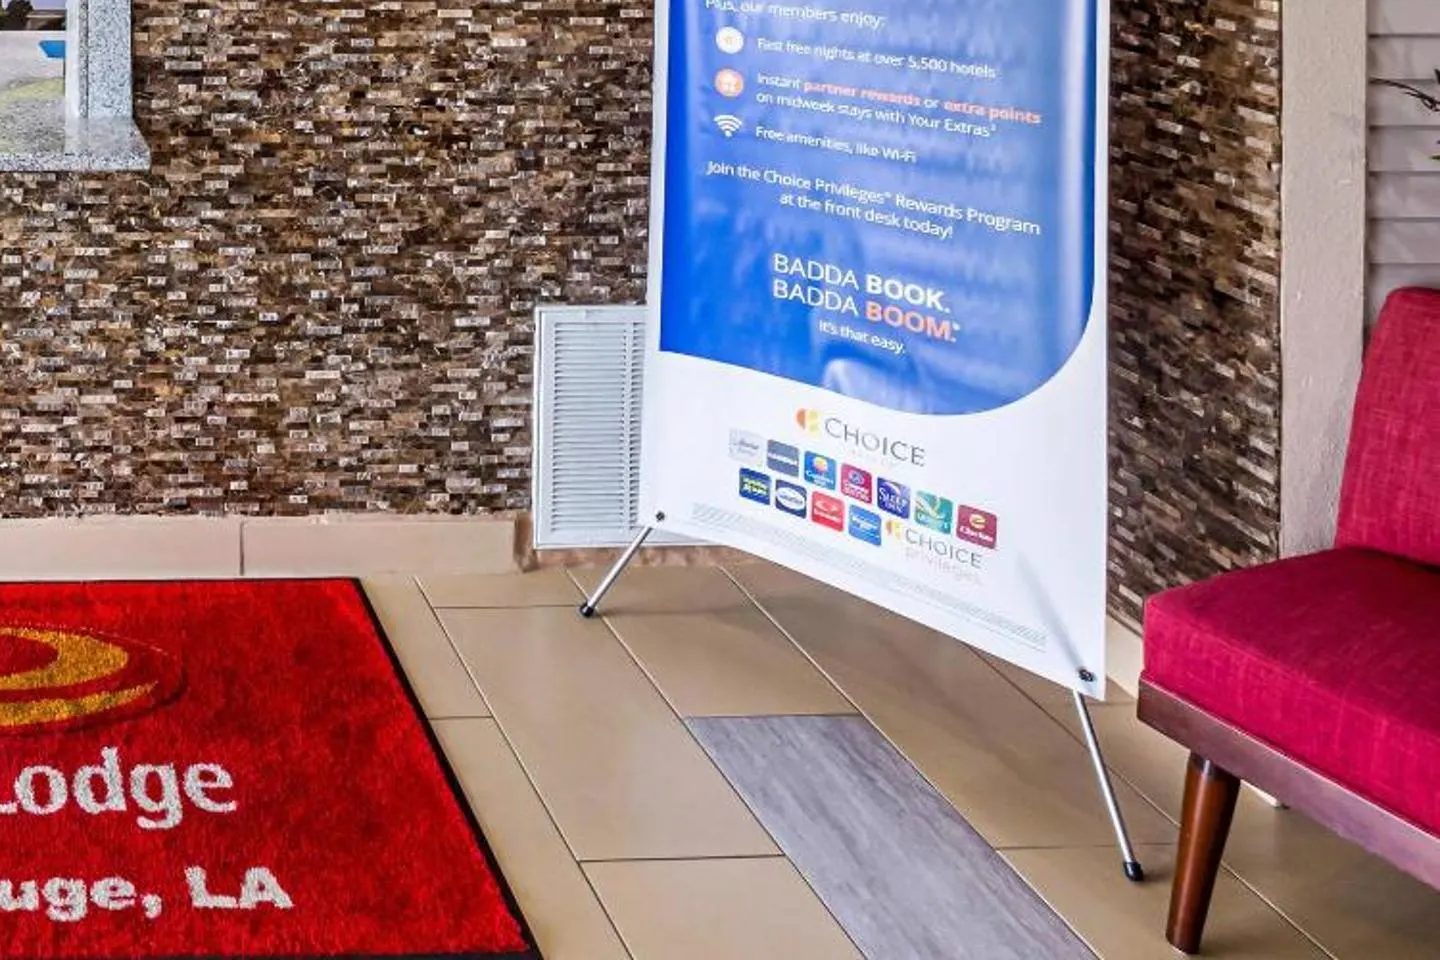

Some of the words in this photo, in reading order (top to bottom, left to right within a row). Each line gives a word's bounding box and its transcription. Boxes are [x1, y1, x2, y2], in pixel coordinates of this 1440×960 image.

[740, 1, 764, 13] our
[768, 3, 838, 22] members
[813, 45, 855, 61] nights
[857, 49, 871, 62] at
[874, 53, 905, 67] over
[756, 92, 773, 104] on
[776, 95, 835, 113] midweek
[875, 109, 905, 124] with
[908, 113, 941, 129] Your
[757, 73, 800, 89] Instant
[860, 88, 921, 106] rewards
[924, 97, 939, 108] or
[944, 100, 986, 117] extra
[988, 106, 1041, 124] points
[755, 126, 784, 141] Free
[855, 143, 879, 157] like
[706, 161, 734, 176] Join
[737, 164, 761, 181] the
[763, 169, 811, 189] Choice
[896, 193, 963, 220] Rewards
[967, 208, 1040, 235] Program
[779, 193, 795, 205] at
[798, 195, 821, 211] the
[824, 199, 861, 217] front
[864, 208, 901, 226] desk
[903, 216, 953, 239] today!
[773, 252, 859, 289] BADDA
[865, 274, 951, 313] BOOK.
[773, 279, 859, 317] BADDA
[819, 320, 837, 336] It's
[839, 323, 868, 343] that
[870, 334, 906, 355] easy.
[825, 418, 925, 467] CHOICE
[905, 527, 982, 570] CHOICE
[185, 866, 294, 910] LA
